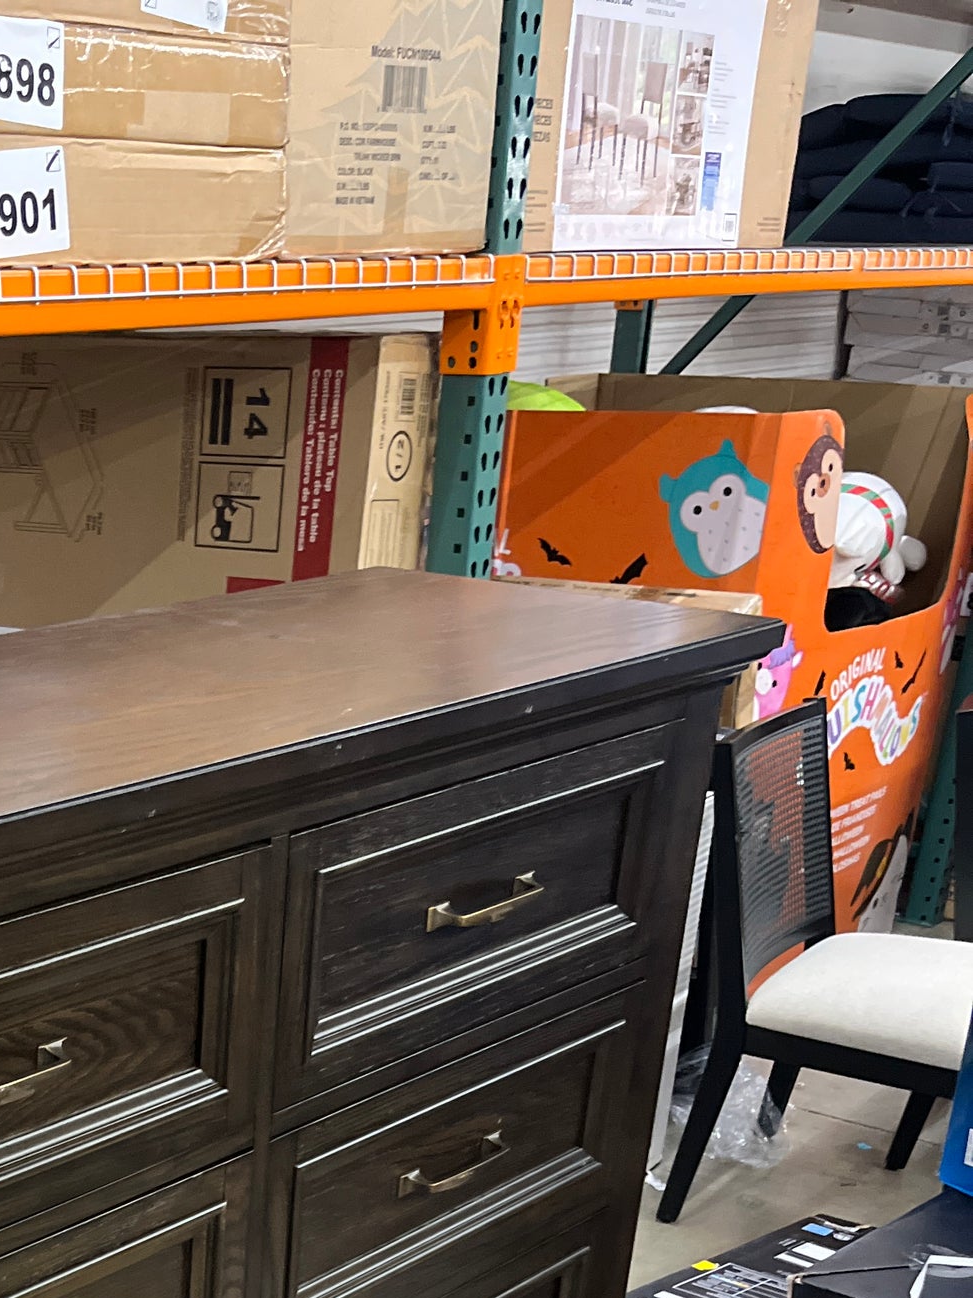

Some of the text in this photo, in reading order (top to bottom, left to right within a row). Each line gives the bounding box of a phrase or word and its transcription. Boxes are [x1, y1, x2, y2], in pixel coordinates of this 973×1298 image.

[243, 388, 270, 440] 14
[303, 438, 315, 484] Tablero
[313, 431, 326, 477] plateau
[327, 432, 338, 466] Table
[302, 487, 310, 503] de
[313, 479, 321, 496] de
[324, 470, 334, 492] Top
[297, 519, 309, 551] mesa
[309, 512, 319, 543] table
[830, 647, 886, 700] ORIGINAL
[827, 678, 923, 761] UISHMALLOWS
